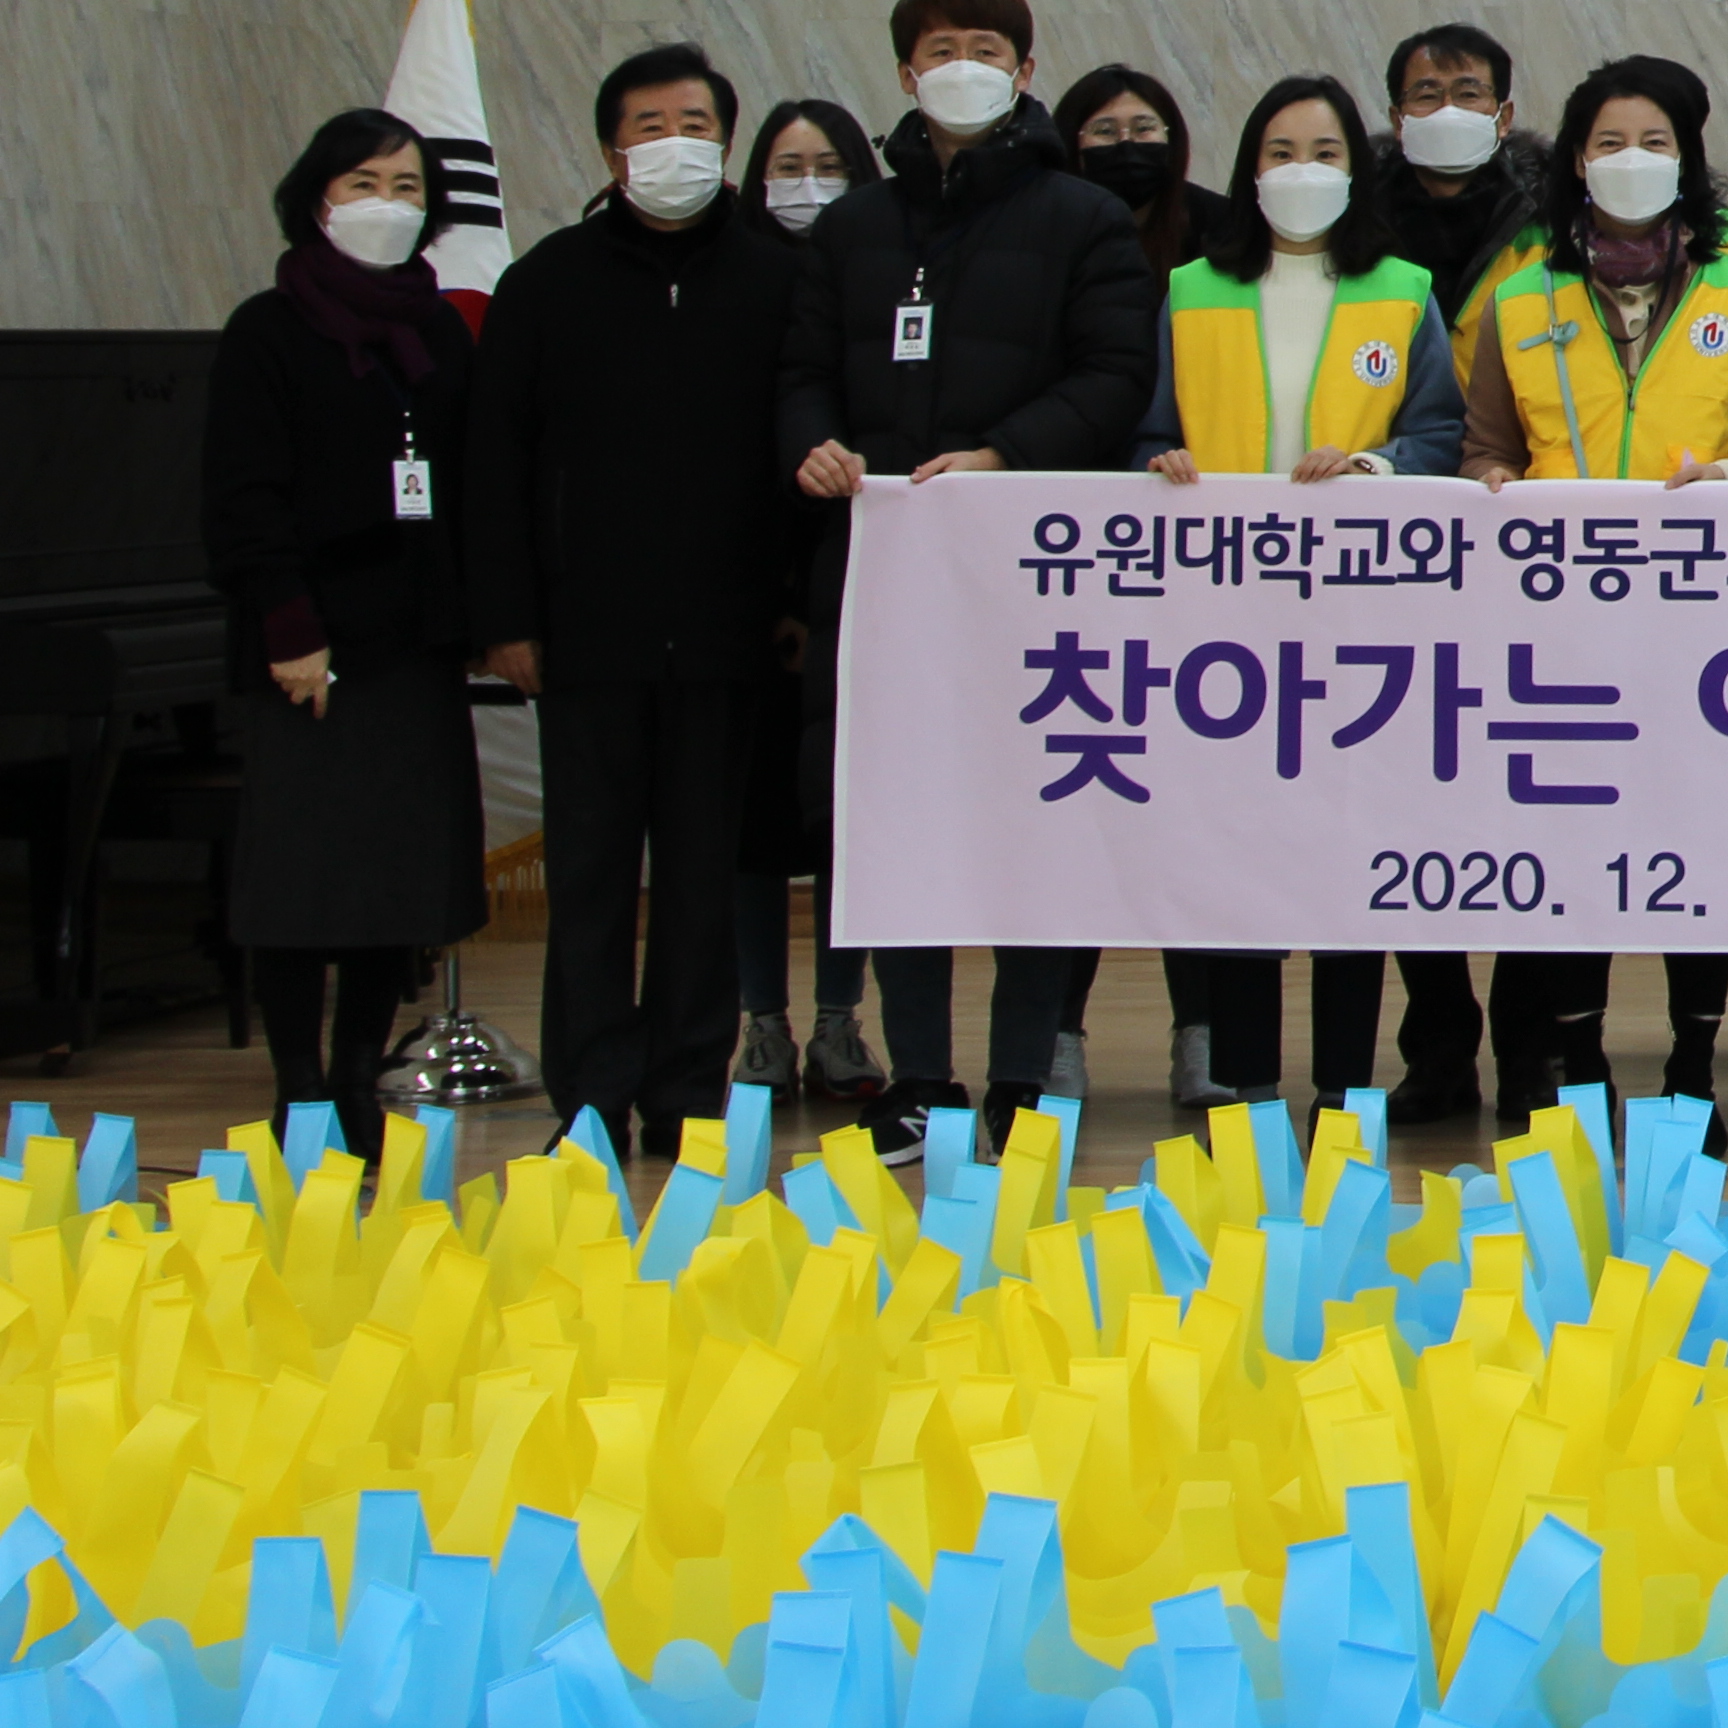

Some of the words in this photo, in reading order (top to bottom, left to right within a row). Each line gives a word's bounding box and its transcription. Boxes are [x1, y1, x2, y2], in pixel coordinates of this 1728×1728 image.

[1019, 512, 1475, 600] 유원대학교와
[1019, 631, 1640, 805] 찾아가는
[1369, 850, 1565, 916] 2020.
[1606, 851, 1706, 917] 12.
